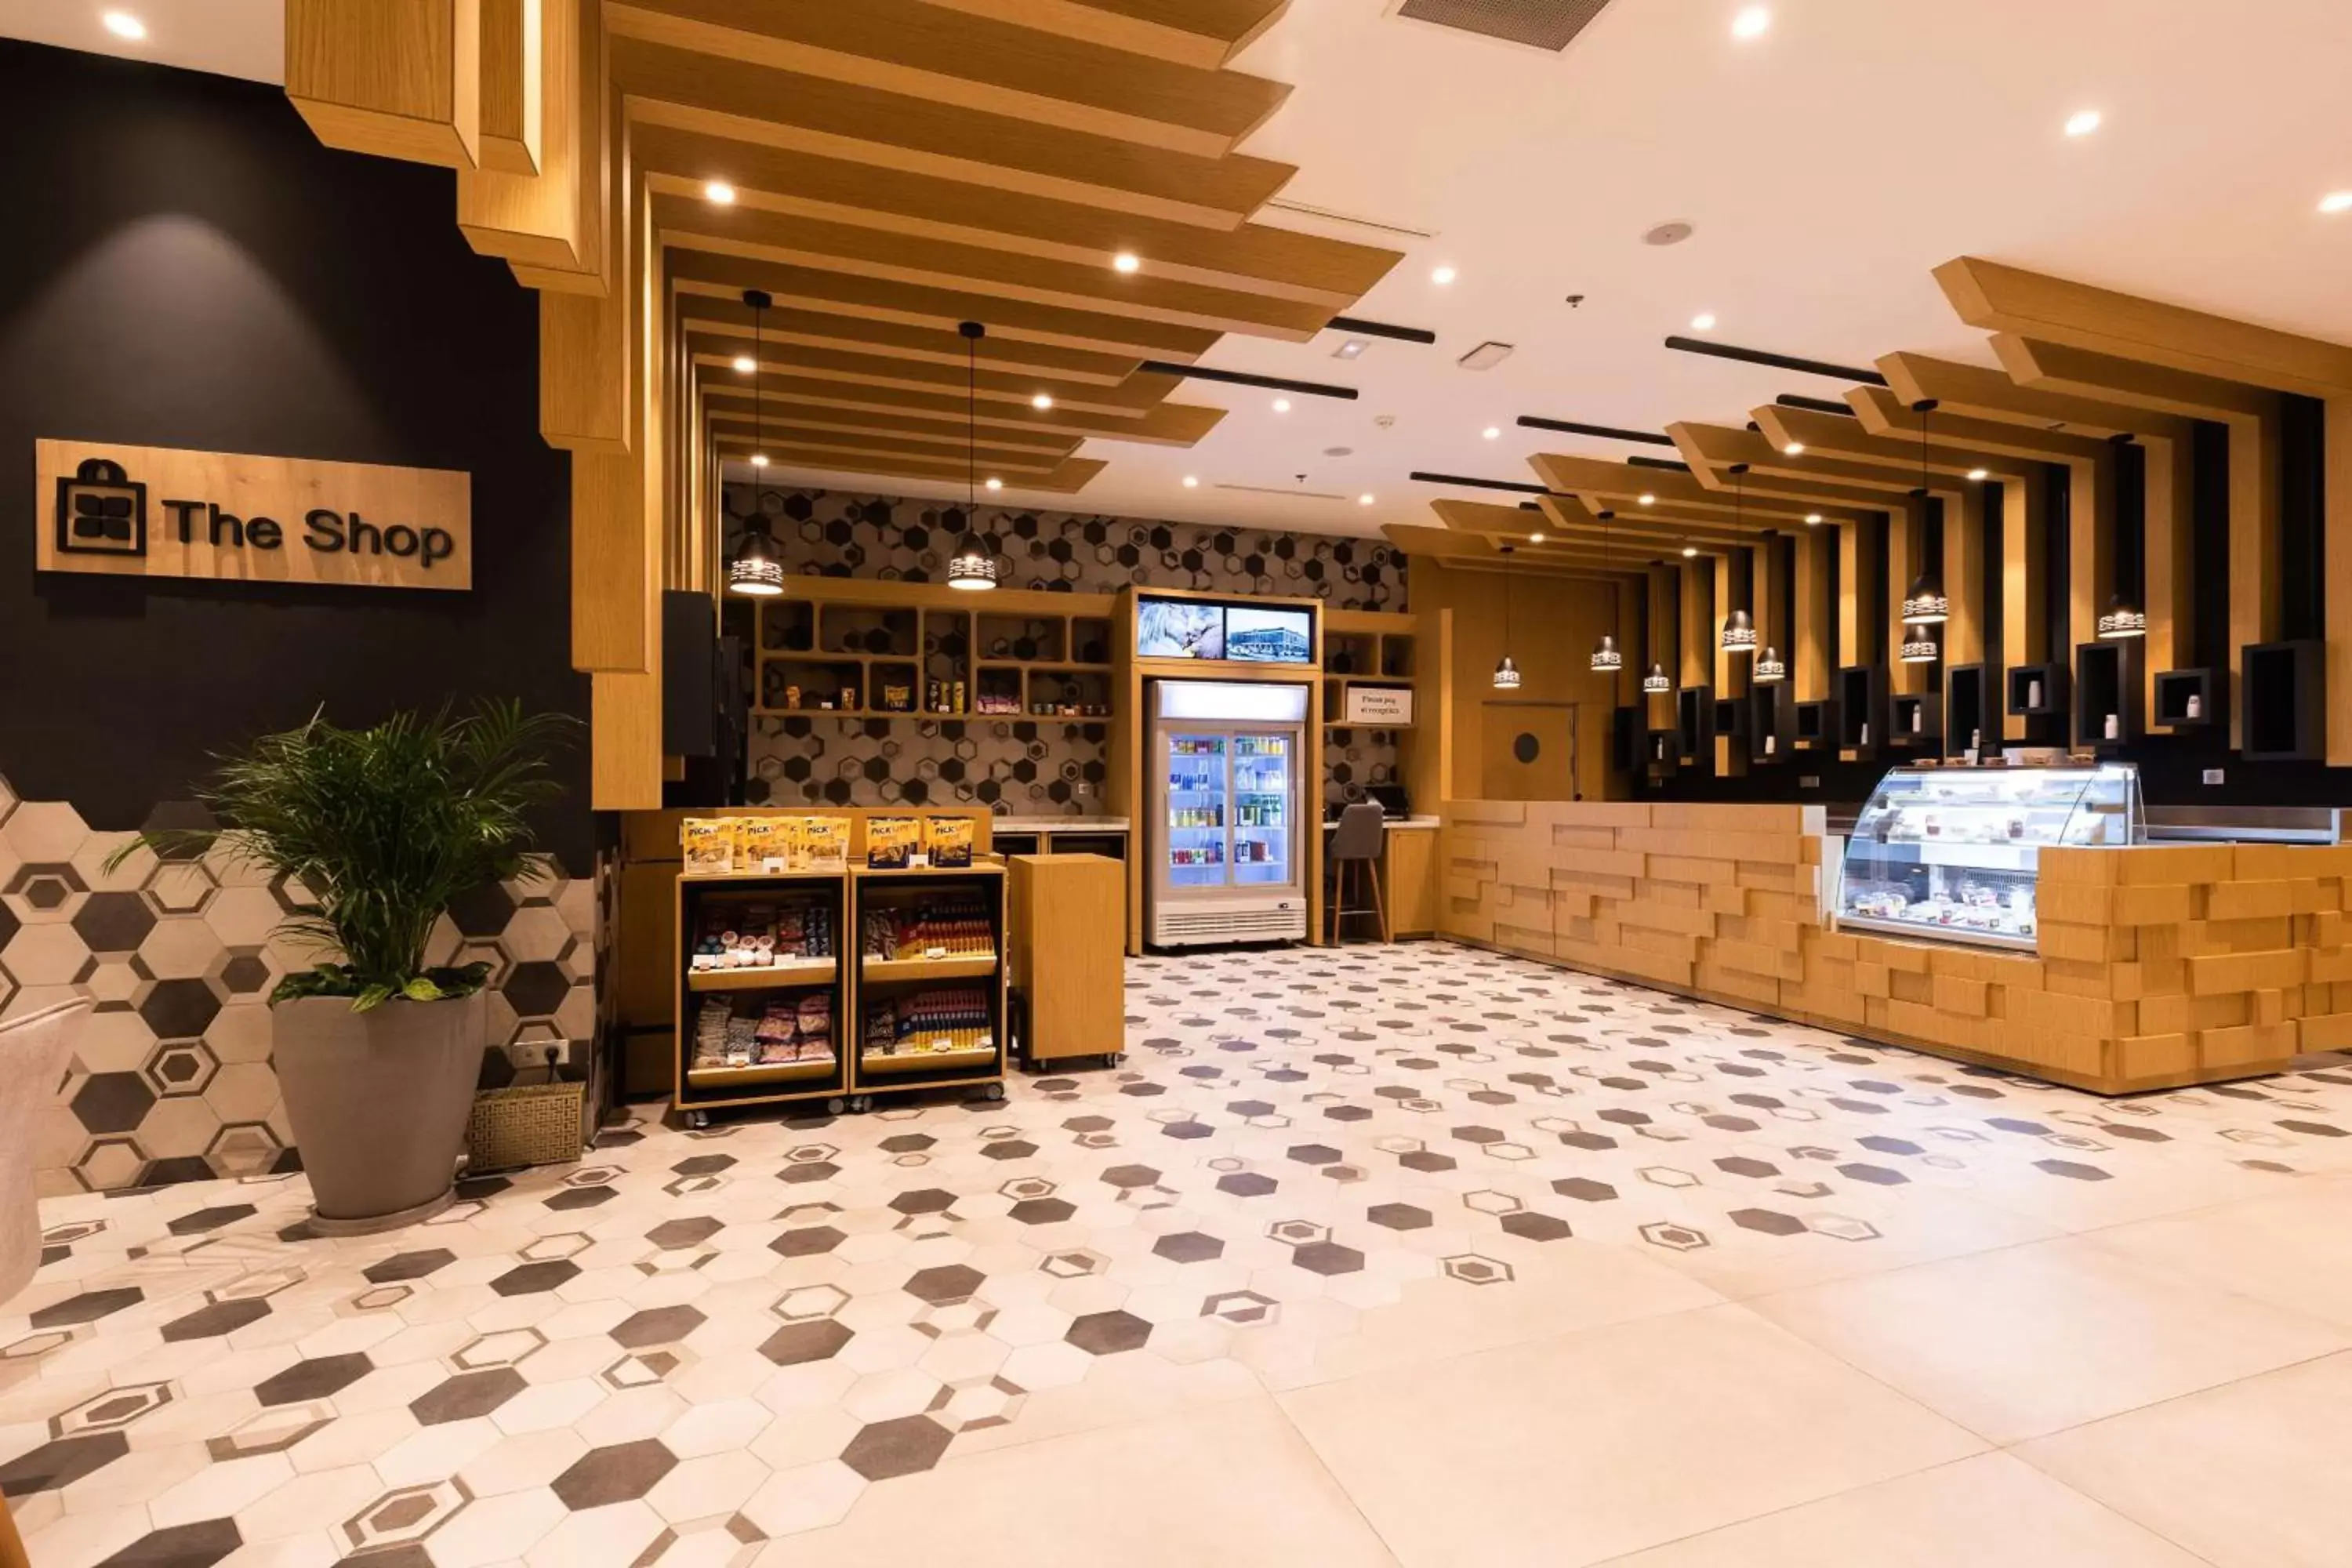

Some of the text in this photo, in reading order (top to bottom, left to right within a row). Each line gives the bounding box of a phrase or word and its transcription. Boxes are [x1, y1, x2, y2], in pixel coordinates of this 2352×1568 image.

[162, 499, 454, 568] The Shop
[688, 827, 712, 837] PICK
[747, 826, 770, 835] PICK
[807, 826, 829, 834] PICK
[871, 826, 891, 836] PICK
[935, 826, 955, 836] PICK
